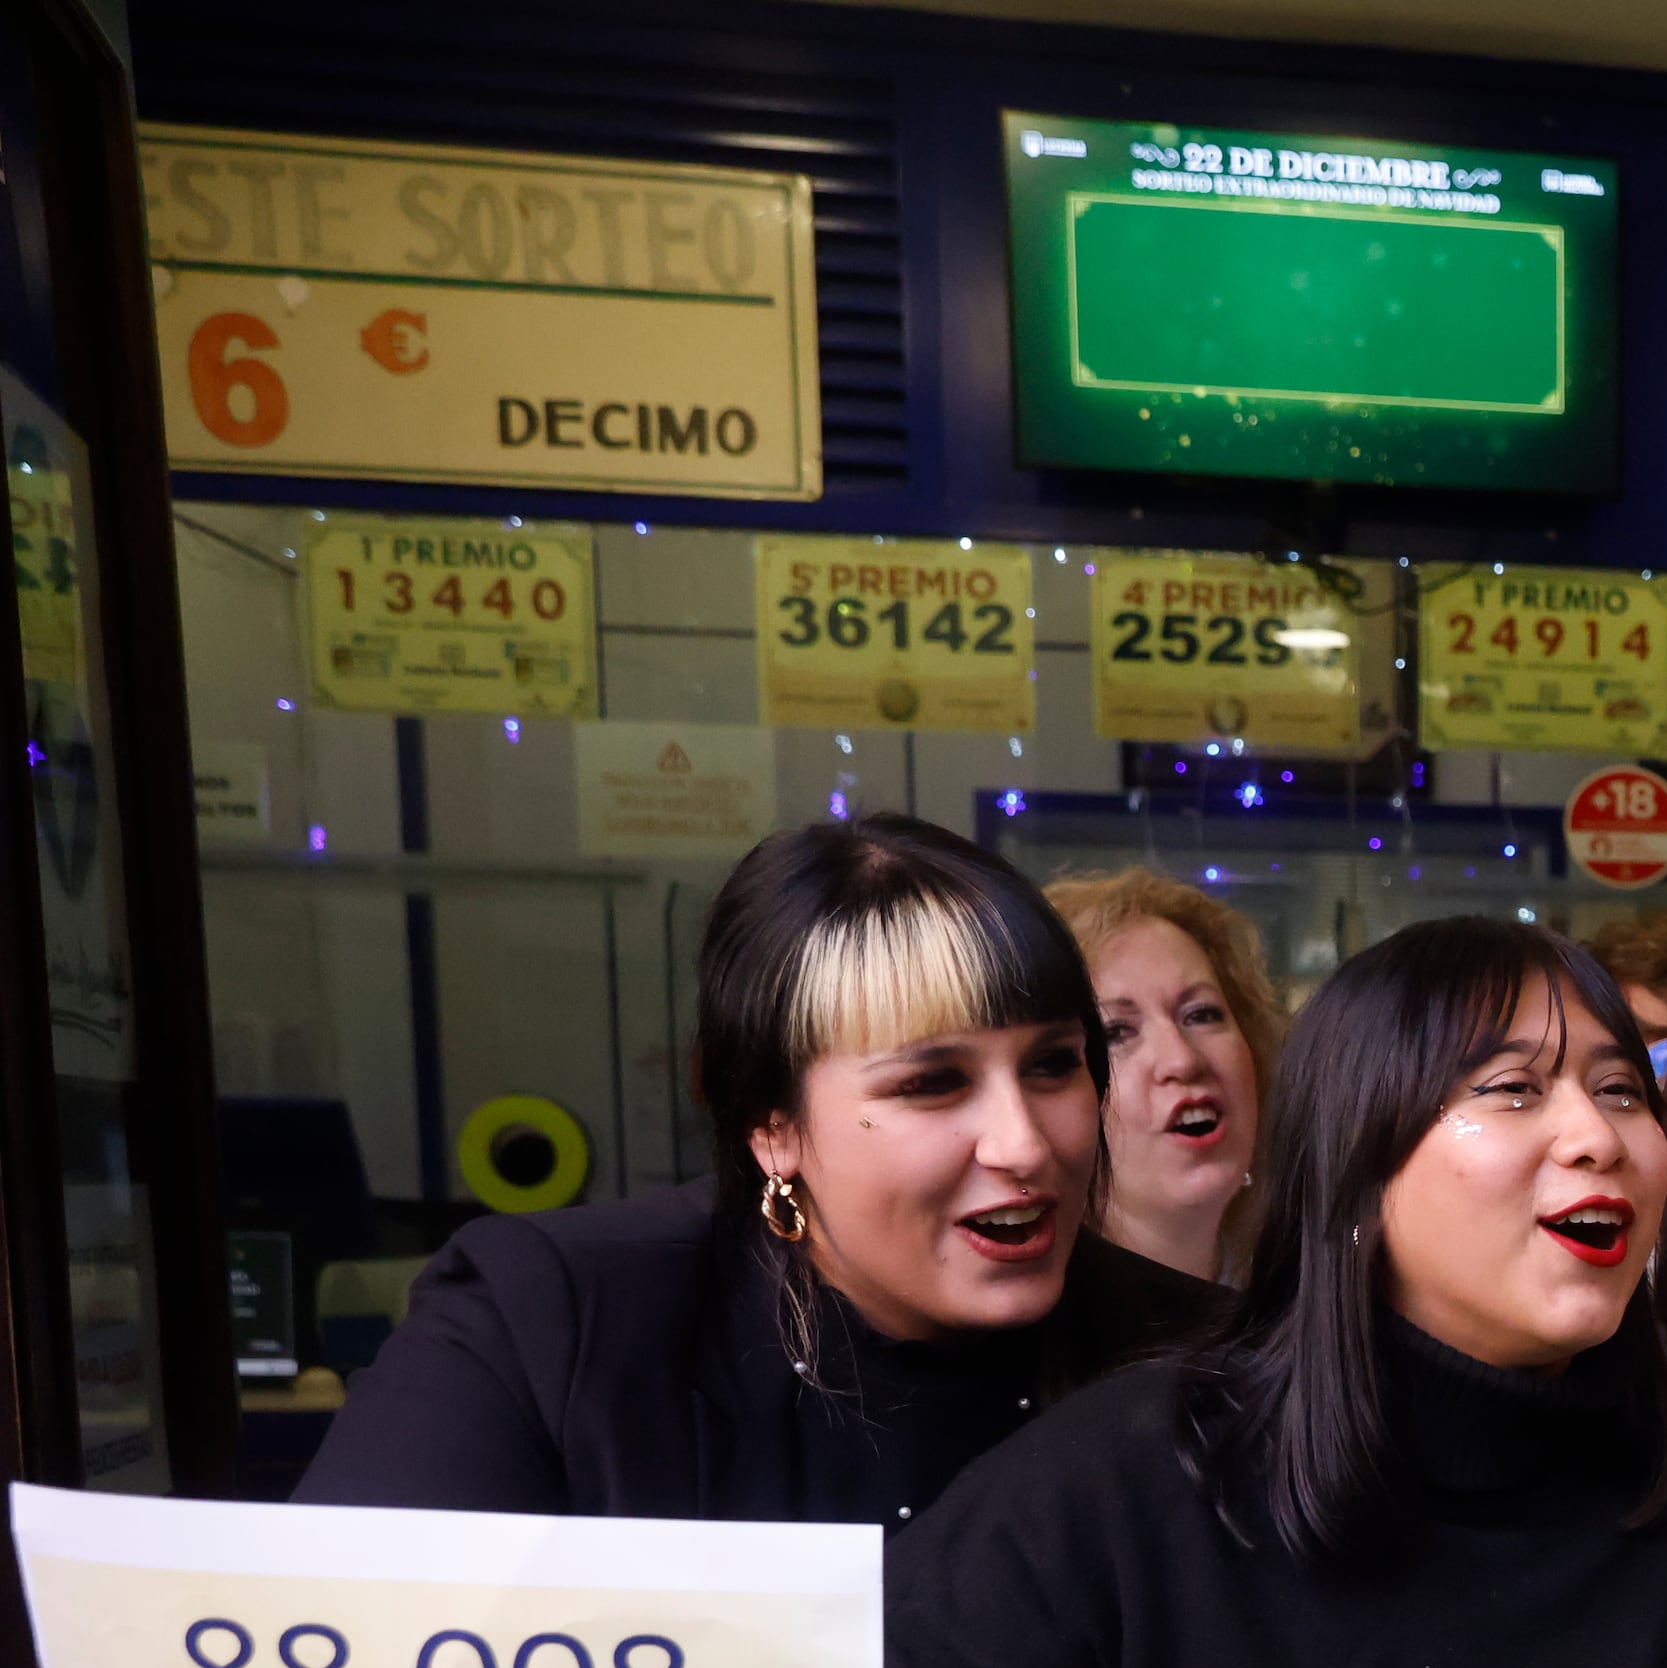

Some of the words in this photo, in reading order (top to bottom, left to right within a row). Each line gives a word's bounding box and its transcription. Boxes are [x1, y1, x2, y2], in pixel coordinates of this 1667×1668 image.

[1131, 168, 1213, 194] SORTEO
[1182, 142, 1223, 174] 22
[1228, 146, 1275, 178] DE
[1277, 149, 1450, 190] DICIEMBRE
[401, 174, 757, 293] SORTEO
[392, 535, 537, 571] PREMIO
[829, 563, 998, 601] PREMIO
[1501, 580, 1631, 617] PREMIO
[777, 596, 1018, 655] 36142
[1593, 779, 1658, 821] +18
